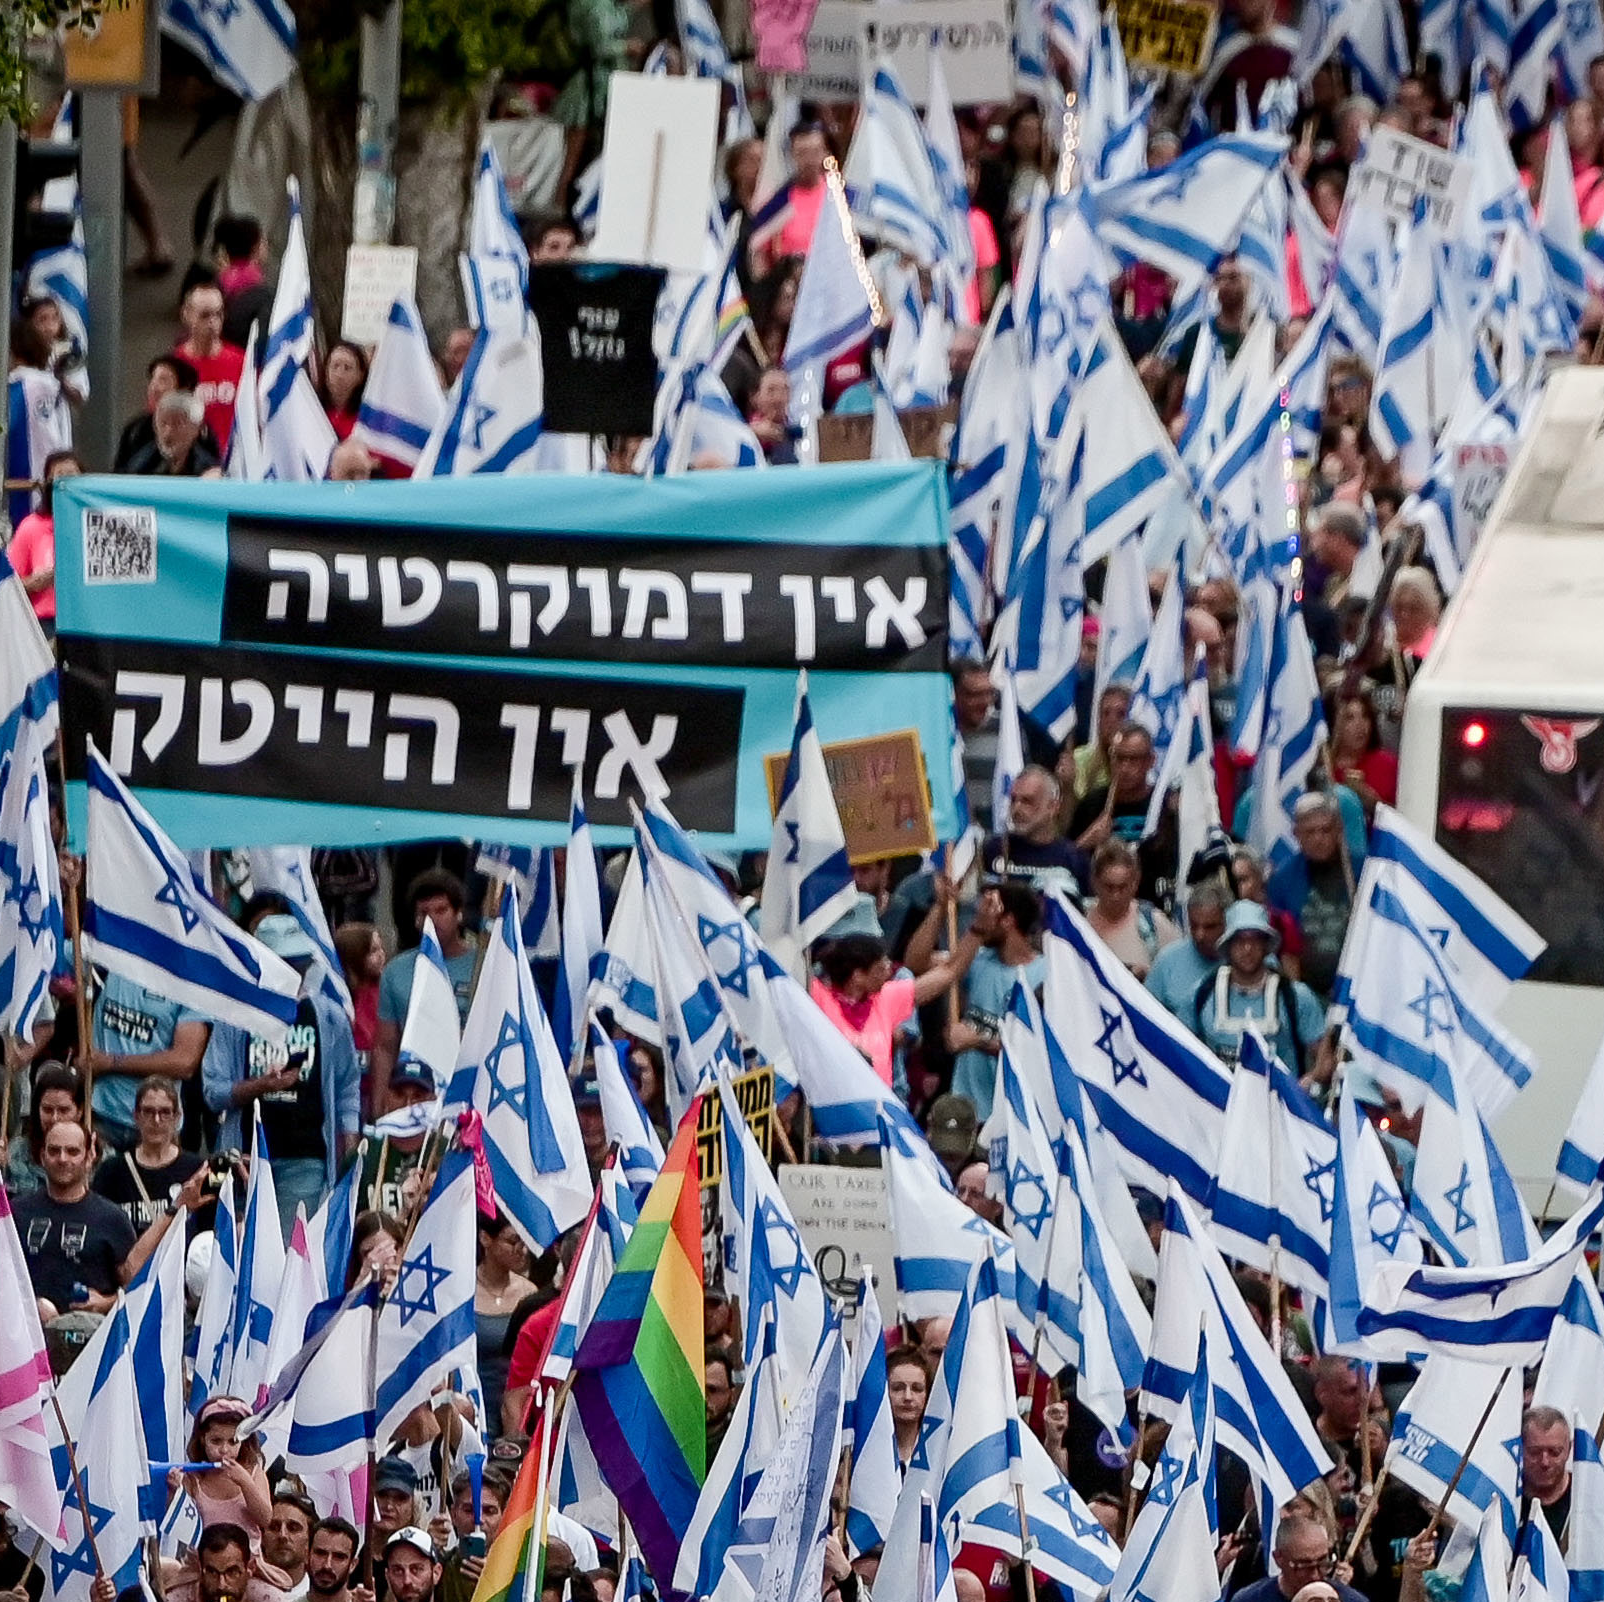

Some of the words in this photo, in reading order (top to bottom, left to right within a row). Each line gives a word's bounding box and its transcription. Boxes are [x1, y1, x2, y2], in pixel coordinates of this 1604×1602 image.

[267, 548, 752, 649] דמוקרטיה
[780, 573, 929, 660] אין
[108, 671, 461, 784] הייטק
[500, 704, 679, 810] אין
[795, 1216, 820, 1227] OWN
